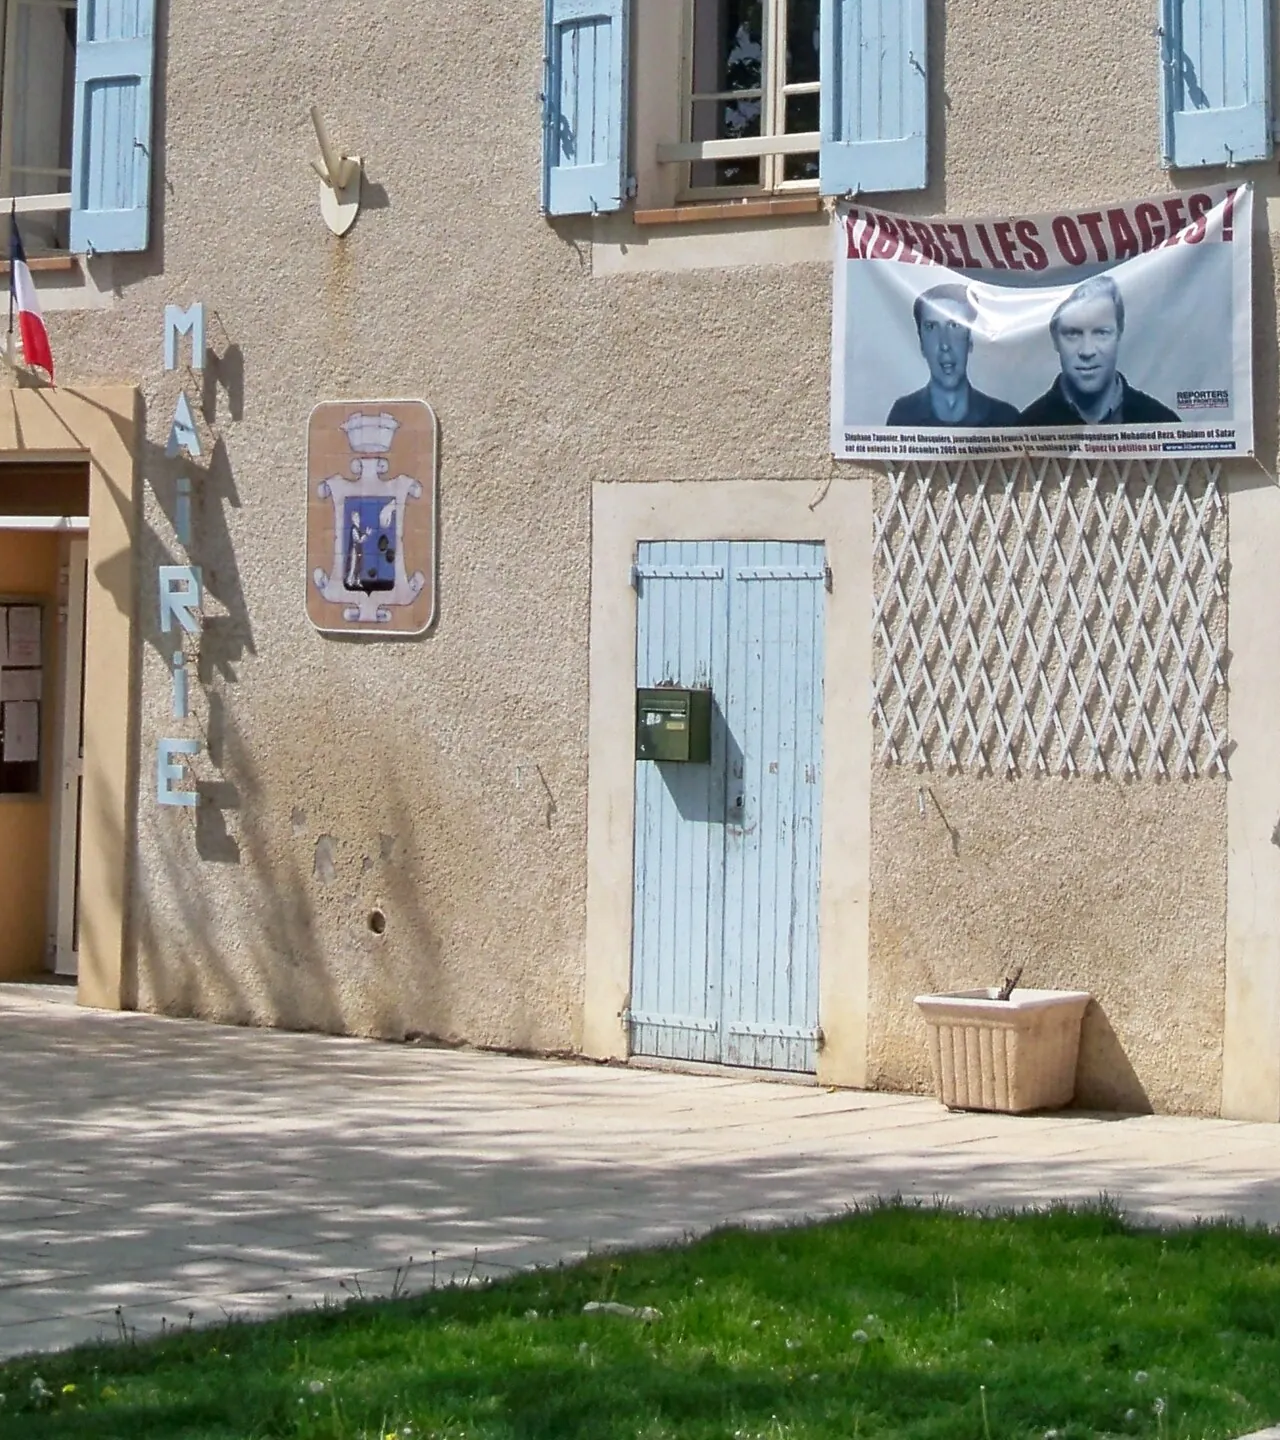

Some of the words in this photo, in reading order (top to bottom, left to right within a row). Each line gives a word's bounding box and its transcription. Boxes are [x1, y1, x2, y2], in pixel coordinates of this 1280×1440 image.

[977, 222, 1050, 271] LES
[1051, 192, 1212, 266] OTAGES
[1223, 189, 1236, 243] !
[1177, 391, 1228, 399] REPORTERS
[1120, 431, 1156, 440] Mohamed
[1177, 429, 1205, 439] Ghulam
[1215, 428, 1235, 438] Satar
